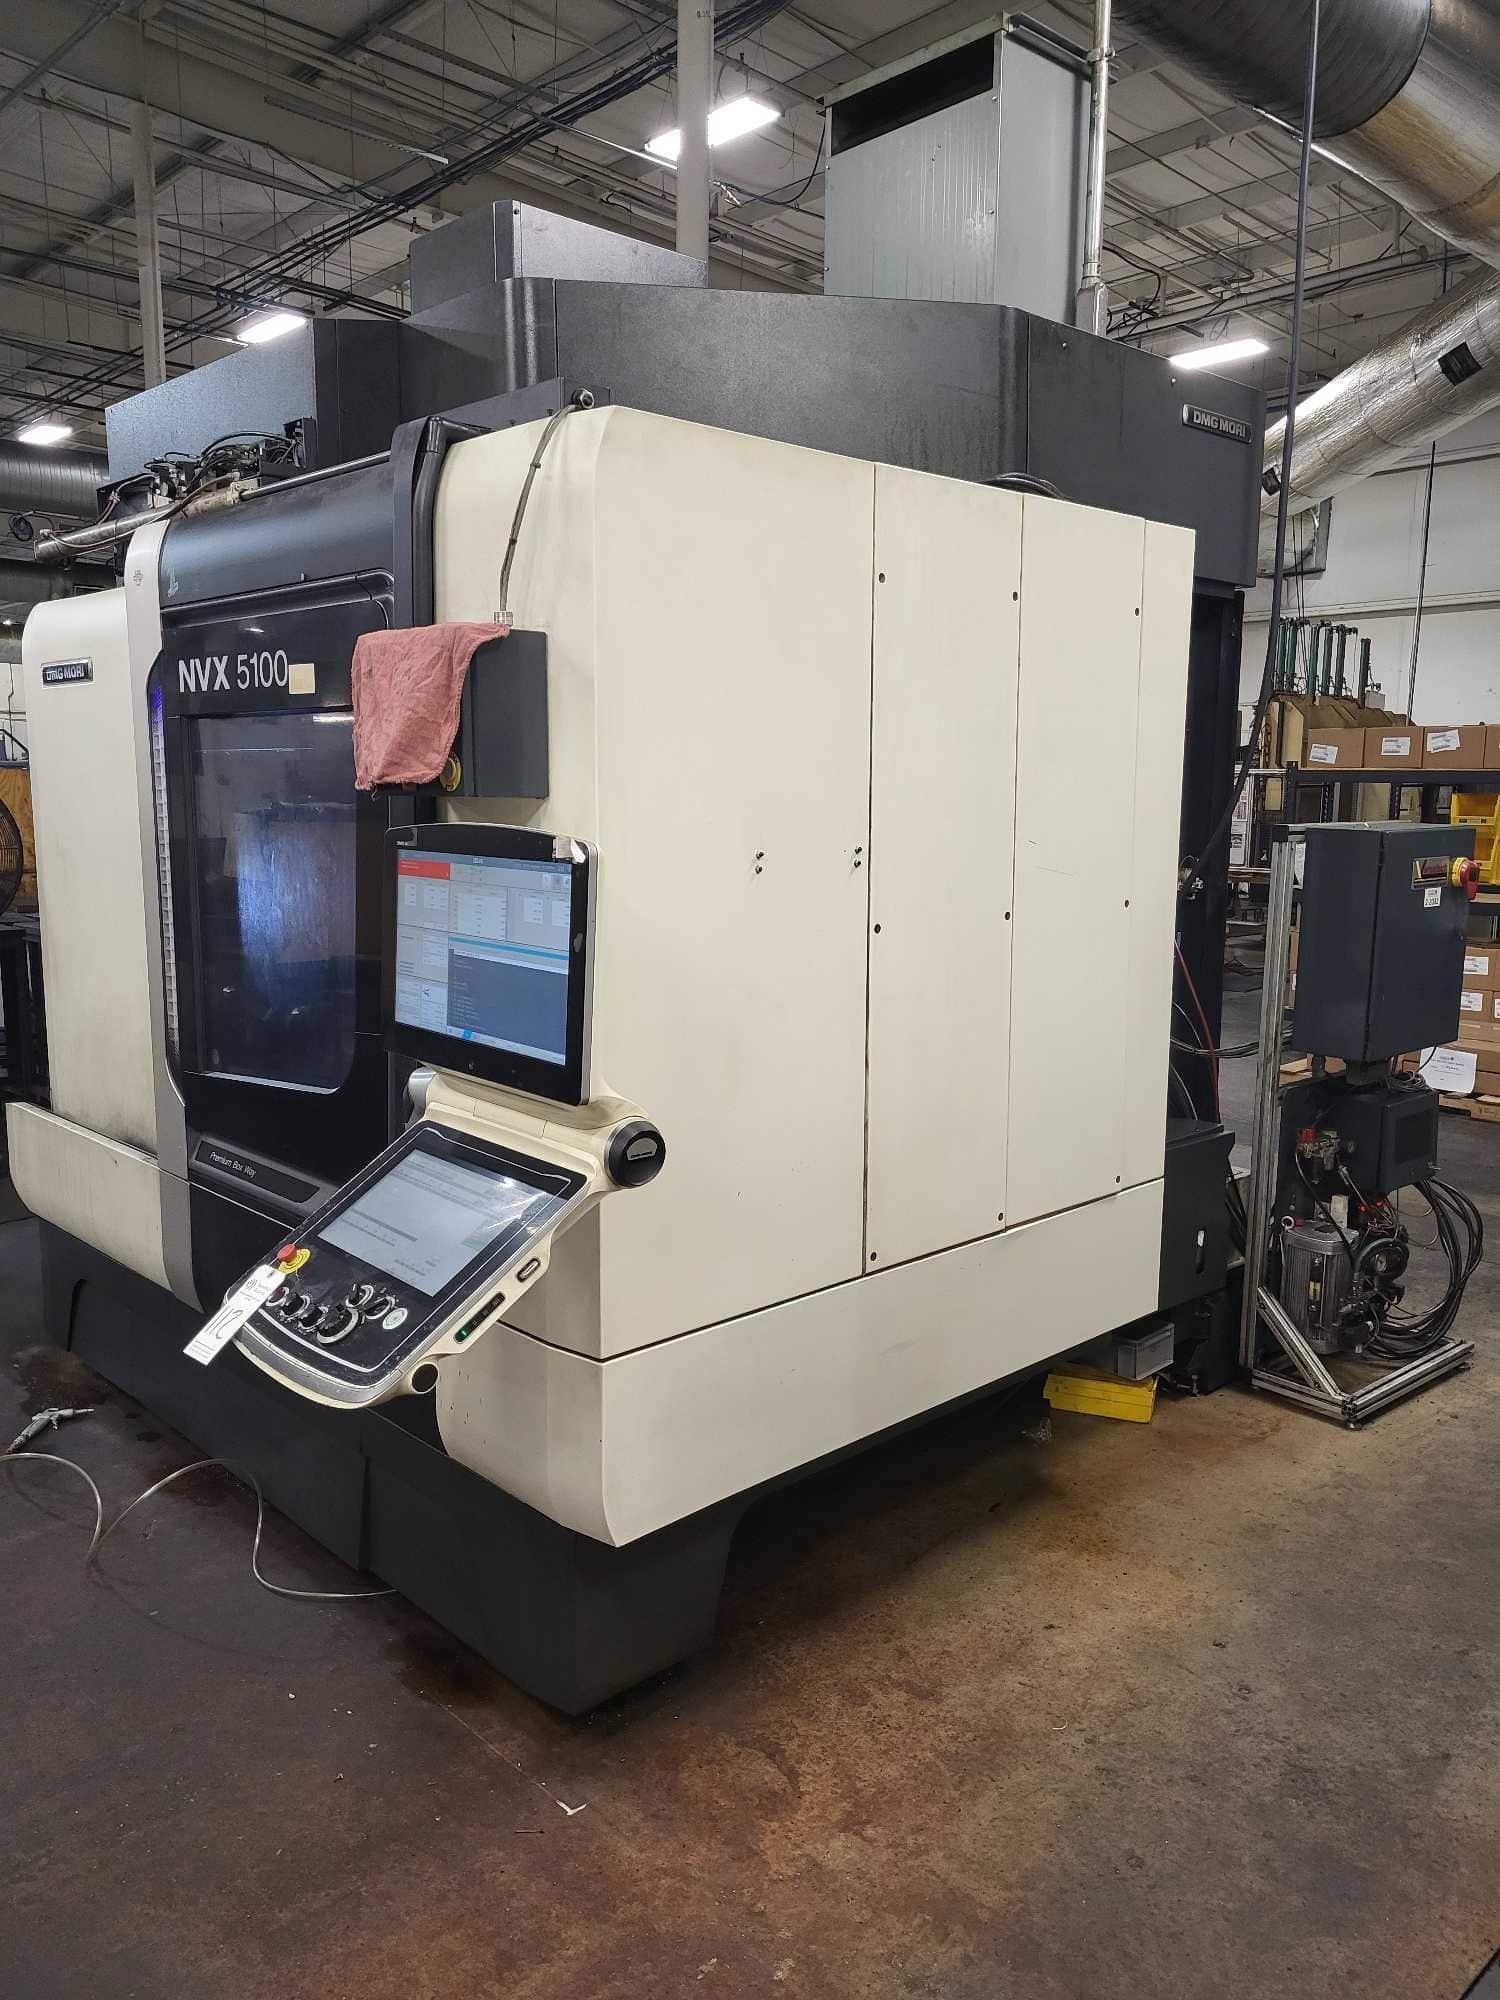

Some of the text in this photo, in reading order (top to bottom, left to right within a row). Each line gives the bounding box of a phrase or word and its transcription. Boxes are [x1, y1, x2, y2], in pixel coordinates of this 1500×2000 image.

[1193, 410, 1246, 437] DMG MORI
[64, 664, 85, 679] MORI
[178, 649, 288, 693] NVX 5100
[209, 1151, 257, 1178] Premium Box Way
